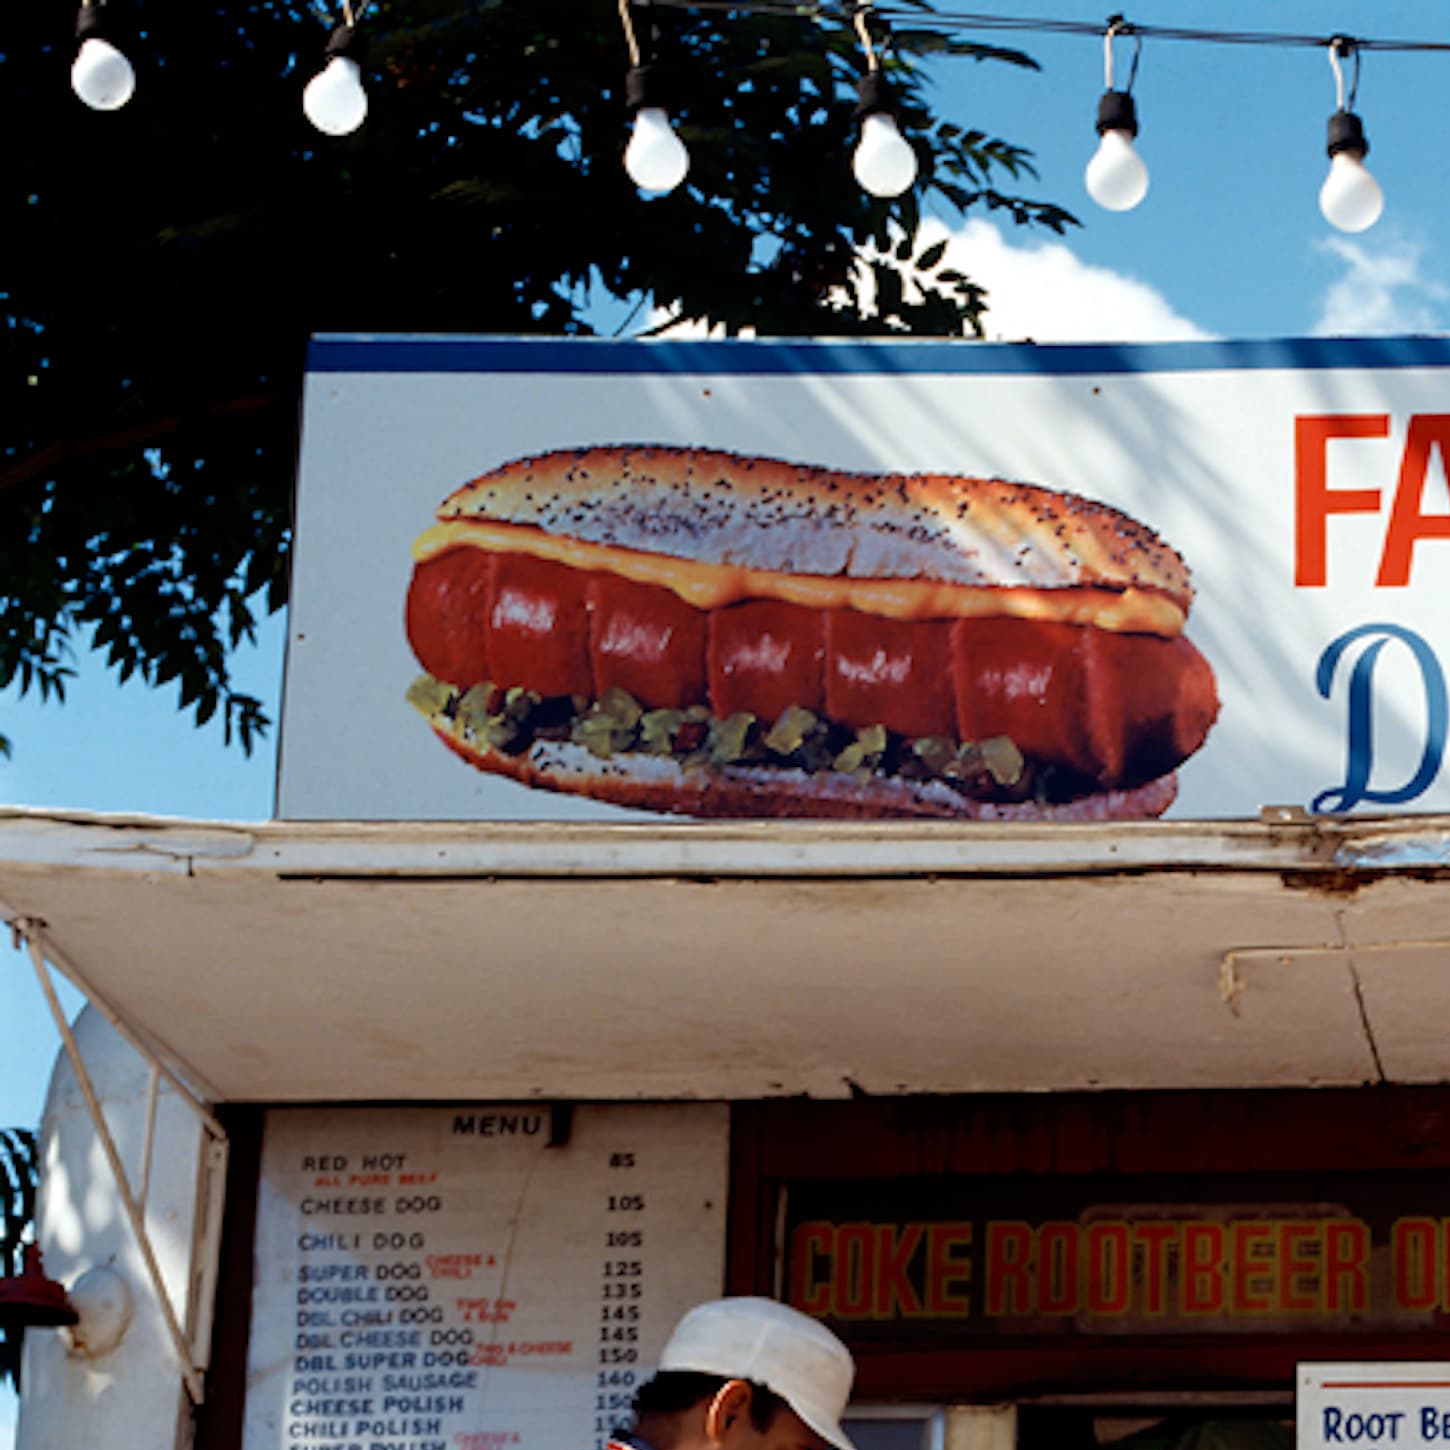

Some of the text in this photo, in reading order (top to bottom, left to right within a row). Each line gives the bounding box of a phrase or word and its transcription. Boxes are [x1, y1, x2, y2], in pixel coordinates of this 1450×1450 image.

[452, 1115, 542, 1136] MENU
[302, 1156, 348, 1172] RED
[362, 1153, 407, 1172] HOT
[300, 1195, 645, 1215] CHEESE DOG 105
[298, 1233, 360, 1251] CHILI
[373, 1232, 425, 1250] DOG
[297, 1261, 643, 1283] SUPER DOG 125
[791, 1220, 973, 1320] COKE
[984, 1217, 1373, 1320] ROOTBEER
[297, 1283, 643, 1304] DOUBLE DOG 135
[297, 1306, 640, 1327] DBL CHILI DOG 145
[296, 1327, 639, 1350] DBL CHEESE DOG 145
[295, 1349, 638, 1373] DBL SUPER DOG 150
[293, 1371, 635, 1395] POLISH SAUSAGE 140
[290, 1398, 374, 1417] CHEESE
[384, 1396, 465, 1414] POLISH
[289, 1420, 348, 1439] CHILI
[355, 1418, 441, 1437] POLISH
[1322, 1406, 1405, 1443] ROOT
